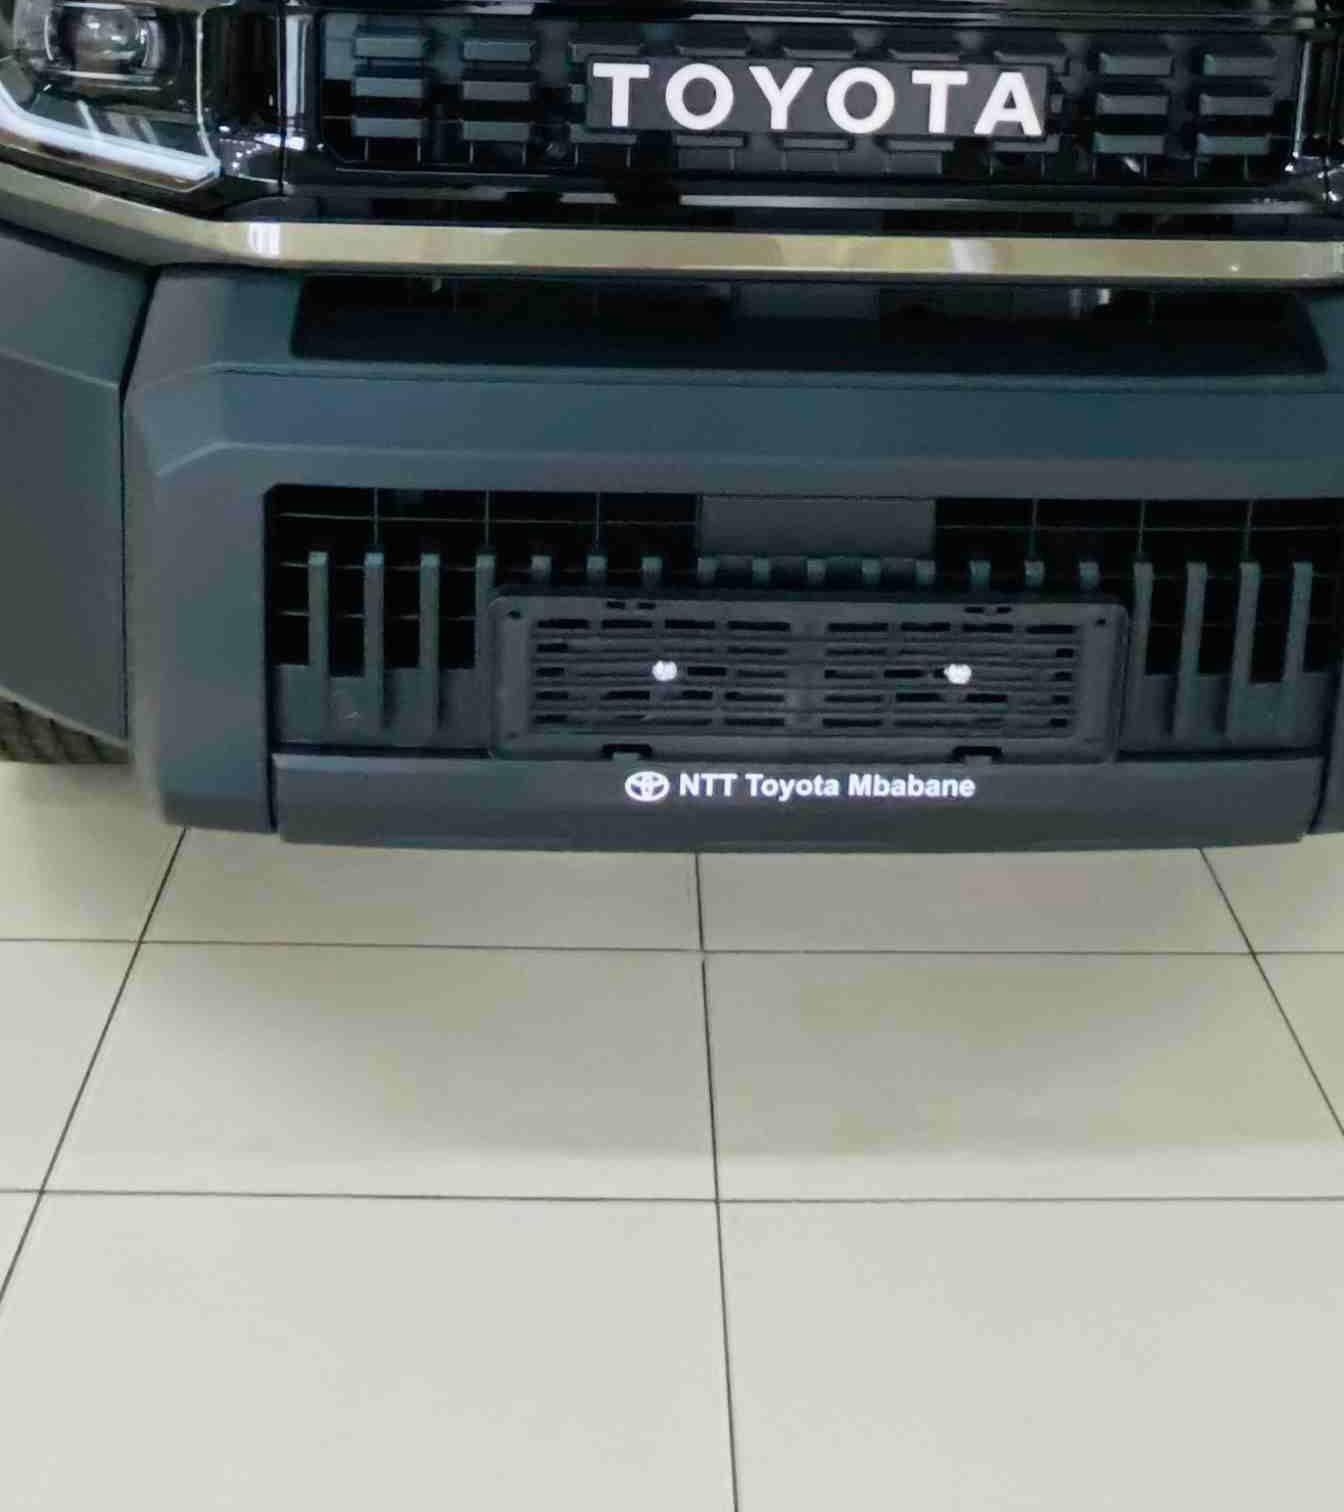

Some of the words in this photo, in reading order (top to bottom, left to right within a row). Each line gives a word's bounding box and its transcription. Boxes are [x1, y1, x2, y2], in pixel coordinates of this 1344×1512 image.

[593, 63, 1042, 136] TOYOTA
[679, 773, 738, 796] NTT
[745, 773, 840, 802] Toyota
[848, 773, 976, 798] Mbabane
